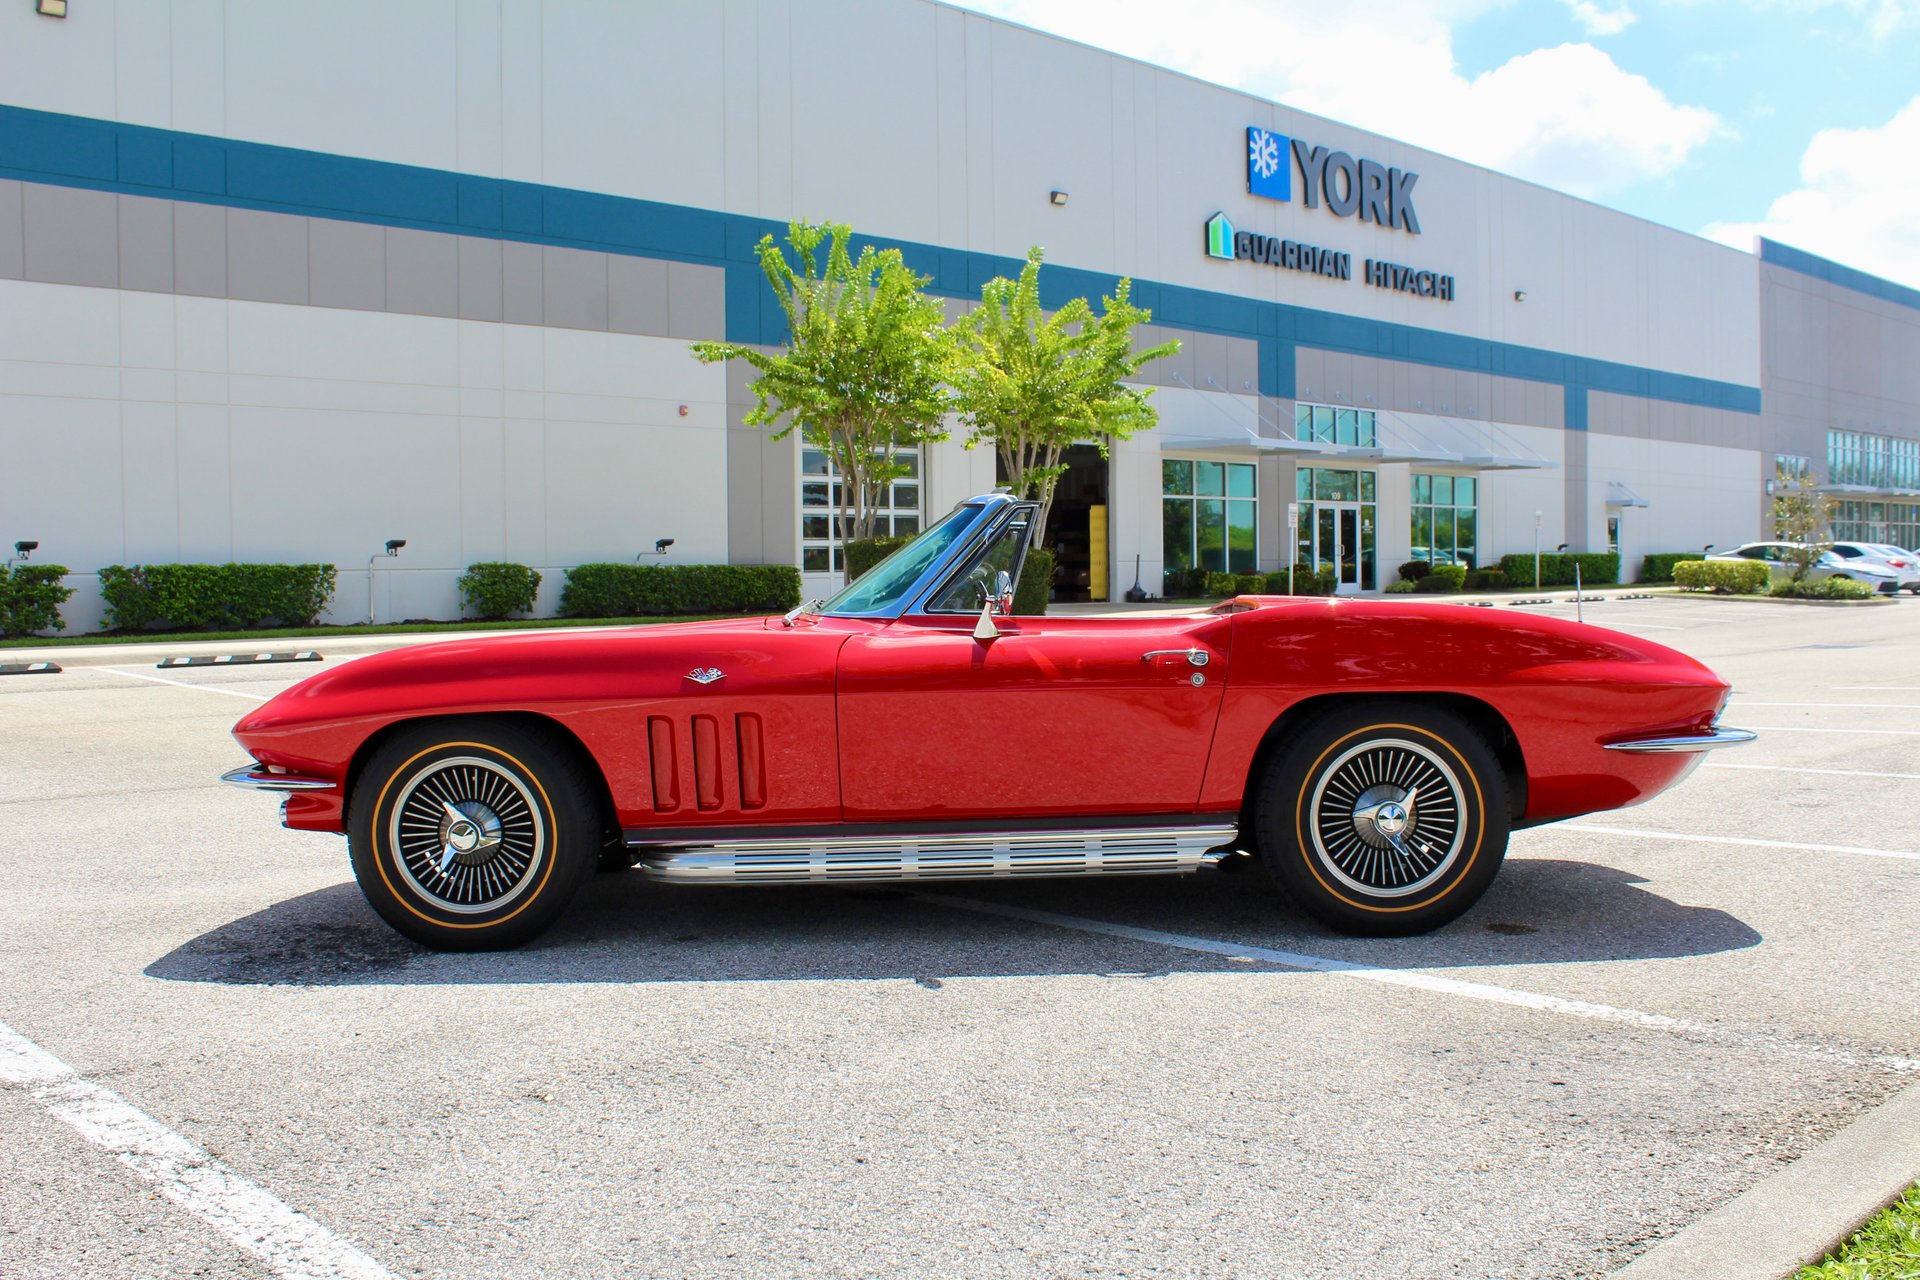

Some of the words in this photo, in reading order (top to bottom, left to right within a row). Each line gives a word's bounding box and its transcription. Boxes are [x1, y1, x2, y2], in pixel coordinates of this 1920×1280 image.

[1292, 139, 1421, 234] YORK
[1235, 231, 1351, 280] GUARDIAN
[1366, 258, 1455, 301] HITACHI
